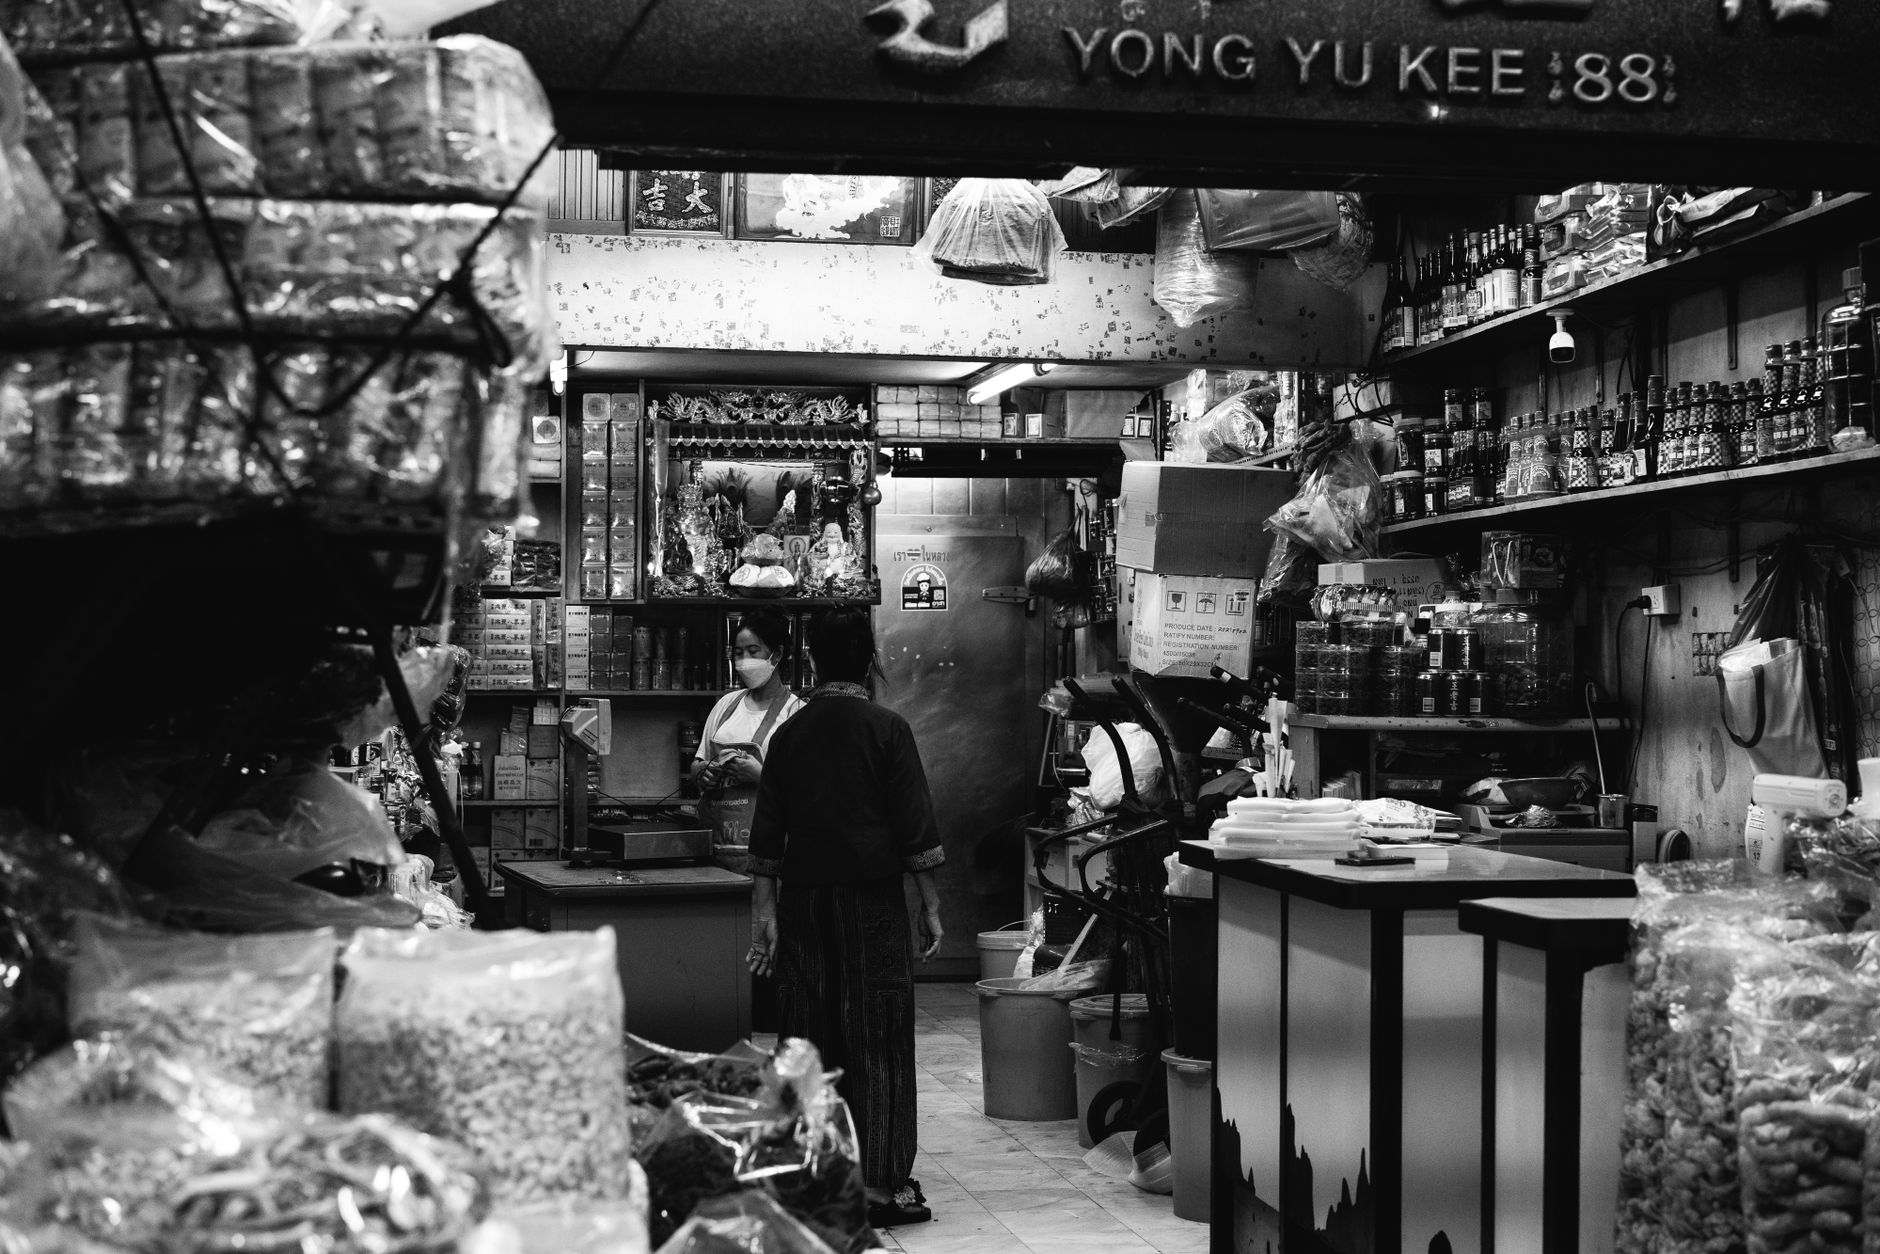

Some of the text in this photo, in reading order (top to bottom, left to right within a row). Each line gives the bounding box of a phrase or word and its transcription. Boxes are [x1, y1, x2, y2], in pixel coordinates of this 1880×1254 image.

[1063, 26, 1256, 80] YONG
[1285, 36, 1373, 89] YU
[1399, 44, 1525, 95] KEE
[893, 551, 906, 562] เรา
[1164, 623, 1196, 631] PRODUCE
[1163, 631, 1186, 639] RATIFY
[1186, 633, 1215, 641] NUMBER:
[1163, 641, 1209, 650] REGISTRATION
